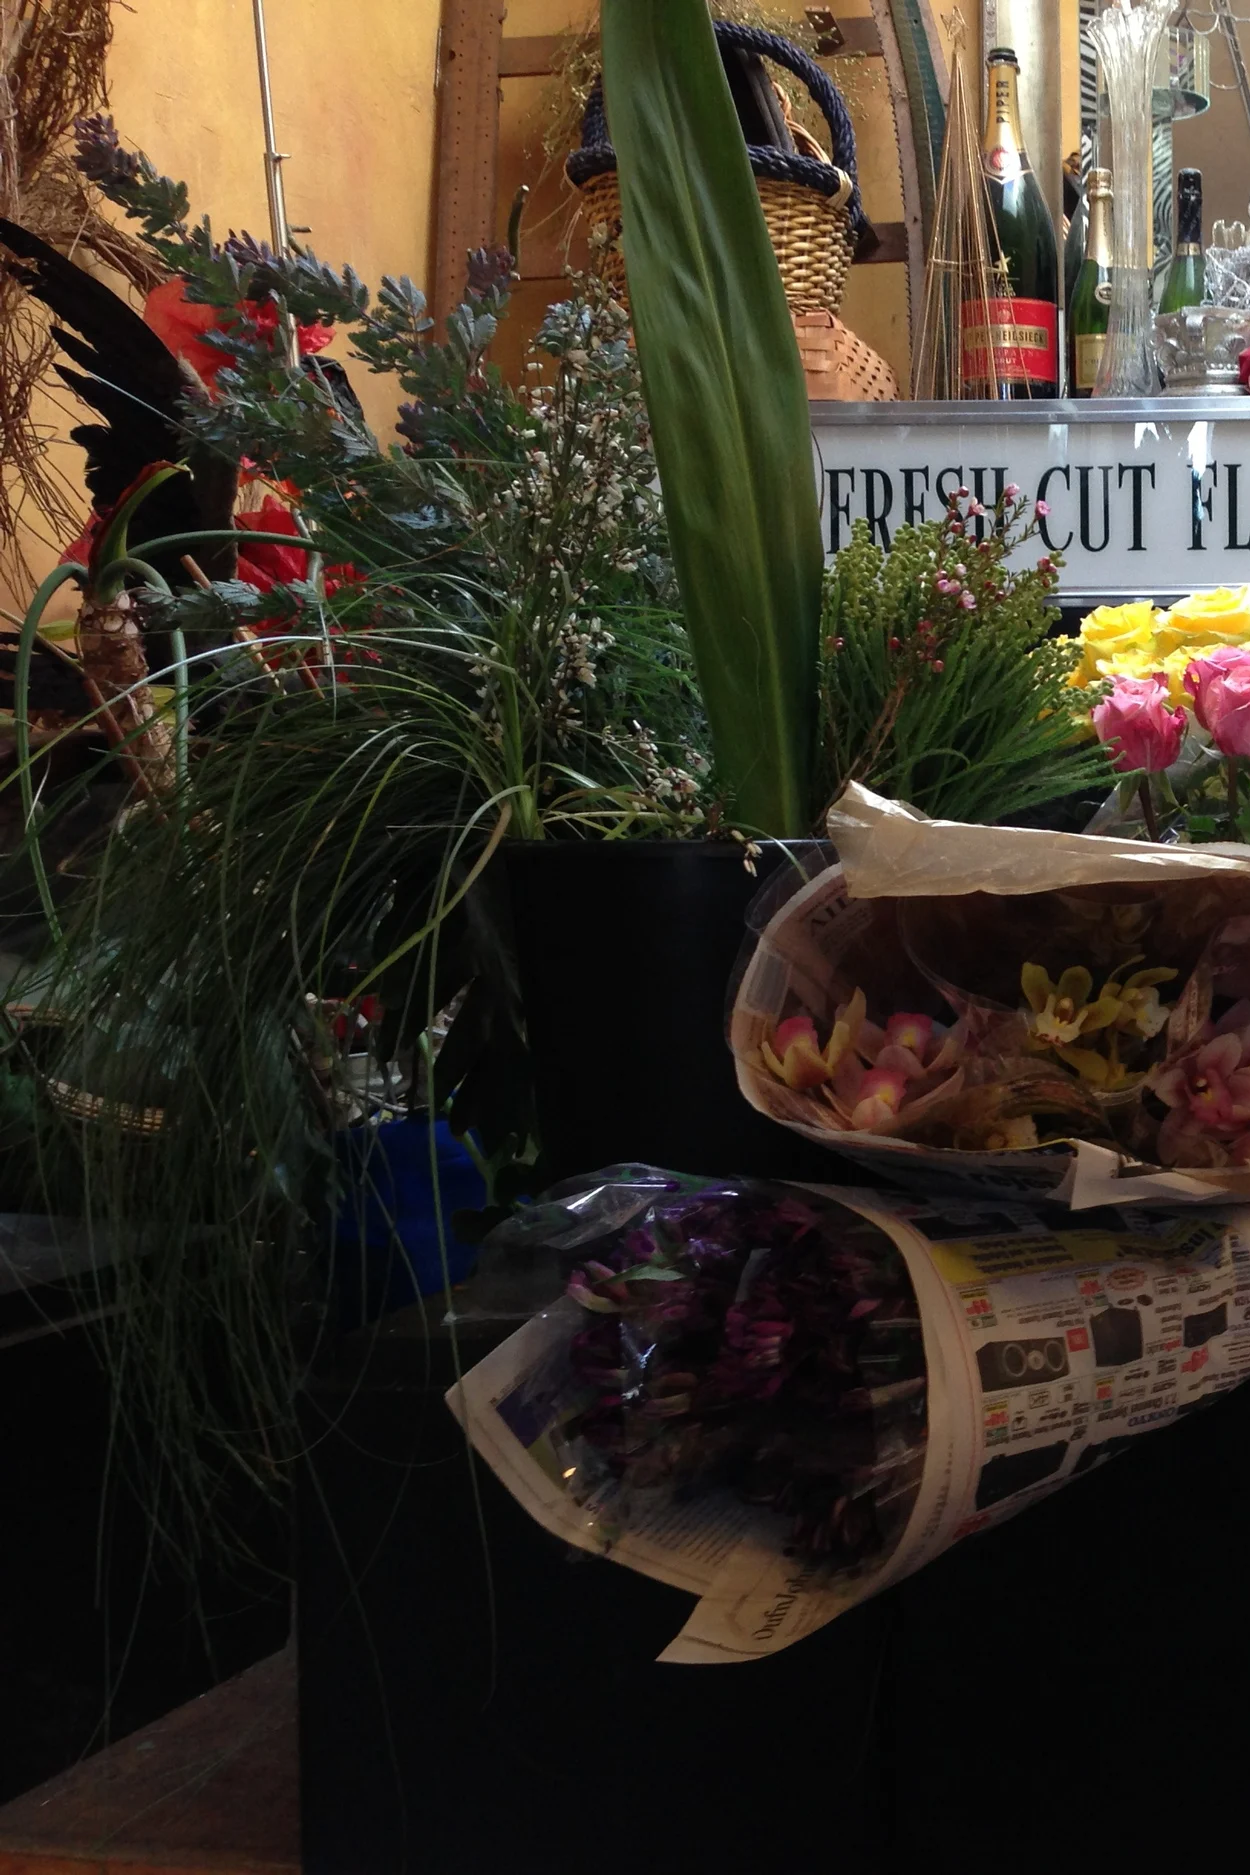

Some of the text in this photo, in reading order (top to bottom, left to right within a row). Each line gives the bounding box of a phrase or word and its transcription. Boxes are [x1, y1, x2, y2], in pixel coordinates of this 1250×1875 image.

[995, 80, 1011, 125] PIPER
[825, 465, 1010, 554] FRESH
[1037, 462, 1157, 553] CUT
